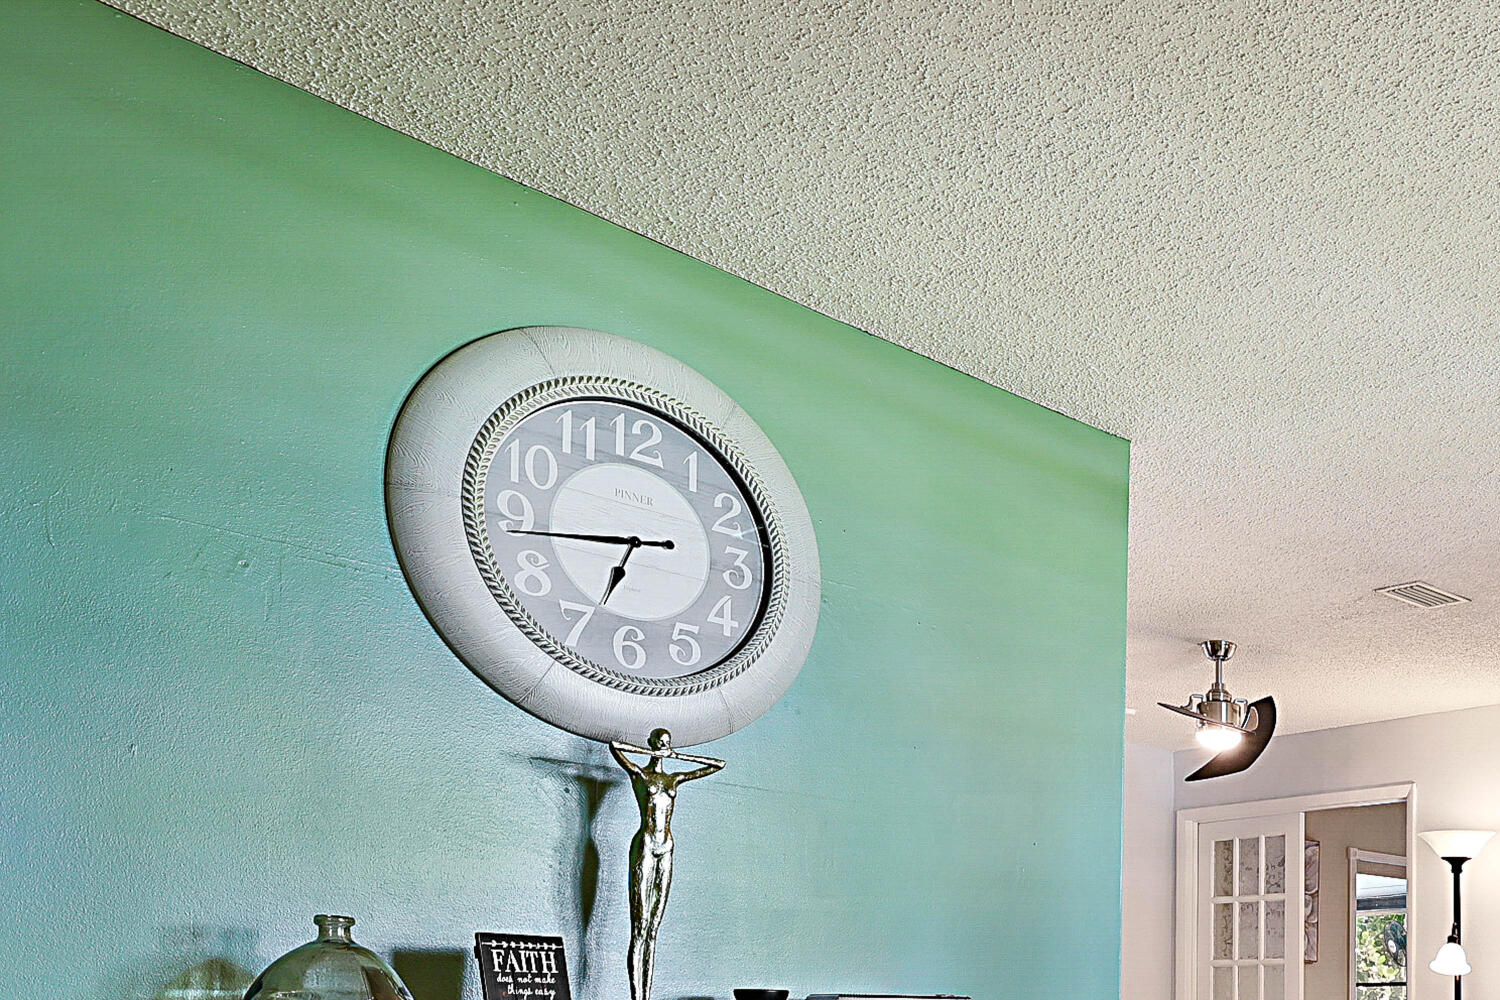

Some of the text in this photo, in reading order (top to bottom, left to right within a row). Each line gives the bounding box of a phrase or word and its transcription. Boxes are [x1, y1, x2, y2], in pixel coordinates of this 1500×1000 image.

[555, 409, 596, 461] 11
[609, 412, 665, 469] 12
[504, 437, 560, 490] 10
[682, 450, 699, 493] 1
[495, 488, 536, 534] 9
[614, 487, 654, 507] PINNER
[711, 491, 742, 537] 2
[513, 549, 553, 598] 8
[721, 546, 753, 591] 3
[558, 598, 596, 649] 7
[706, 595, 740, 638] 4
[612, 624, 648, 671] 6
[667, 621, 702, 667] 5
[491, 949, 559, 974] FAITH
[496, 972, 556, 984] does not make
[507, 983, 557, 1000] things easy
